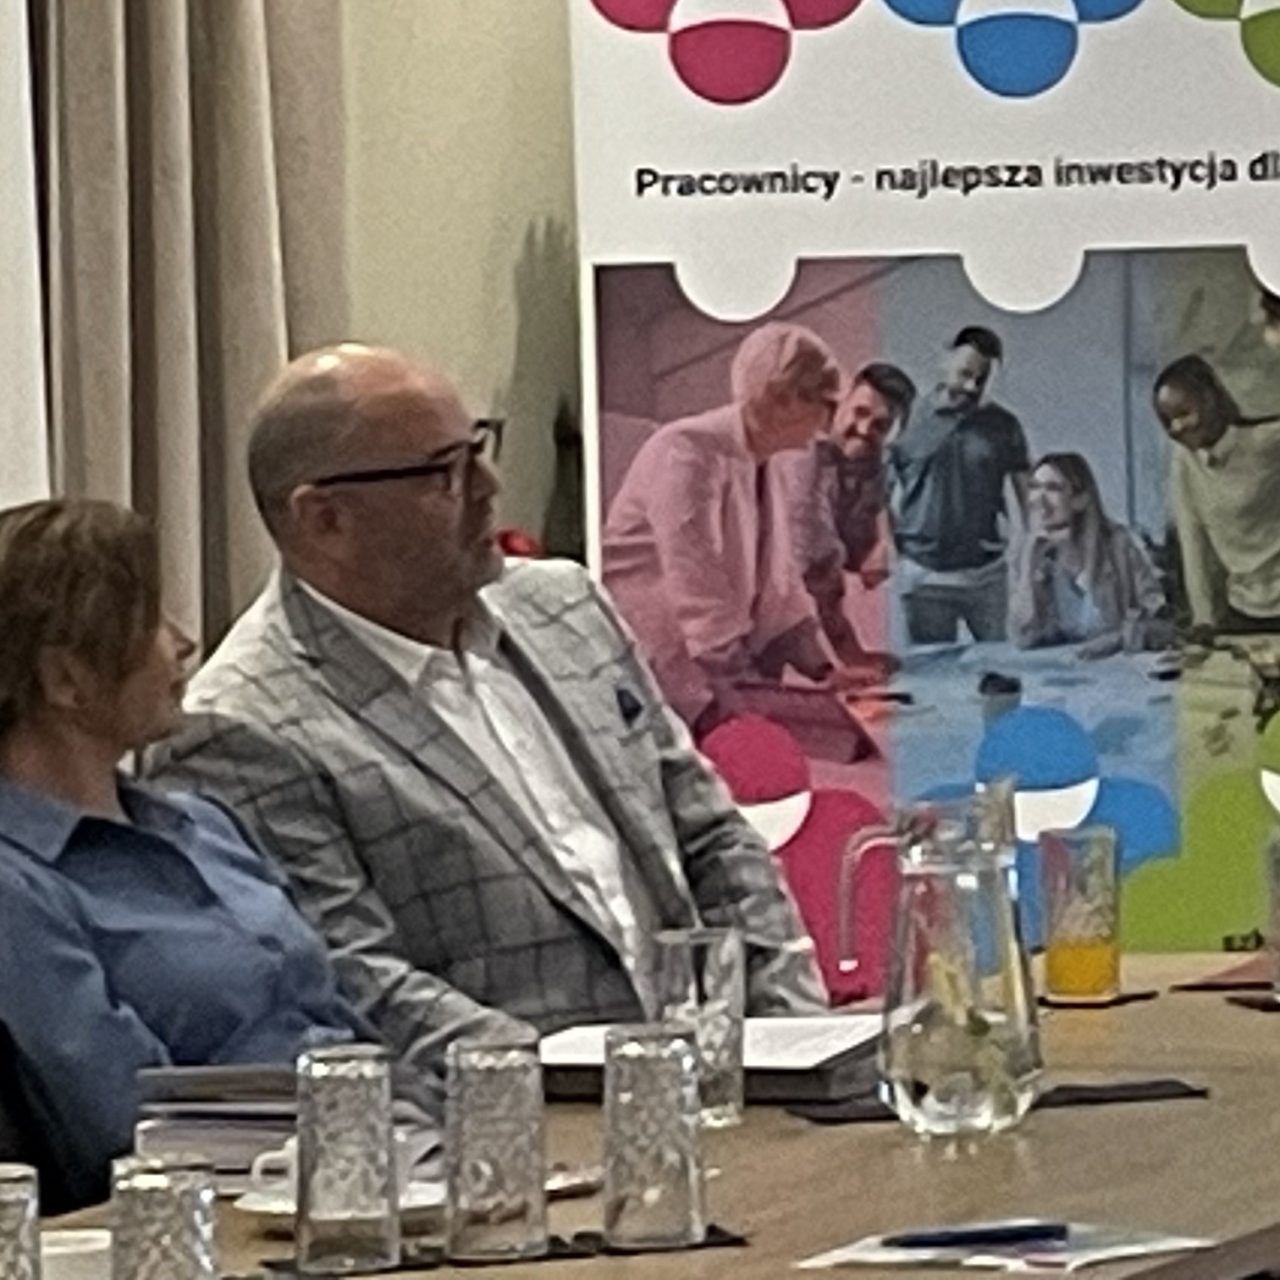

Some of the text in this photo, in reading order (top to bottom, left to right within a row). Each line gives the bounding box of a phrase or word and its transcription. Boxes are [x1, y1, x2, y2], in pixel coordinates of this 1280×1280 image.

[635, 165, 841, 202] Pracownicy
[874, 153, 1044, 200] najlepsza
[1054, 152, 1239, 192] inwestycja
